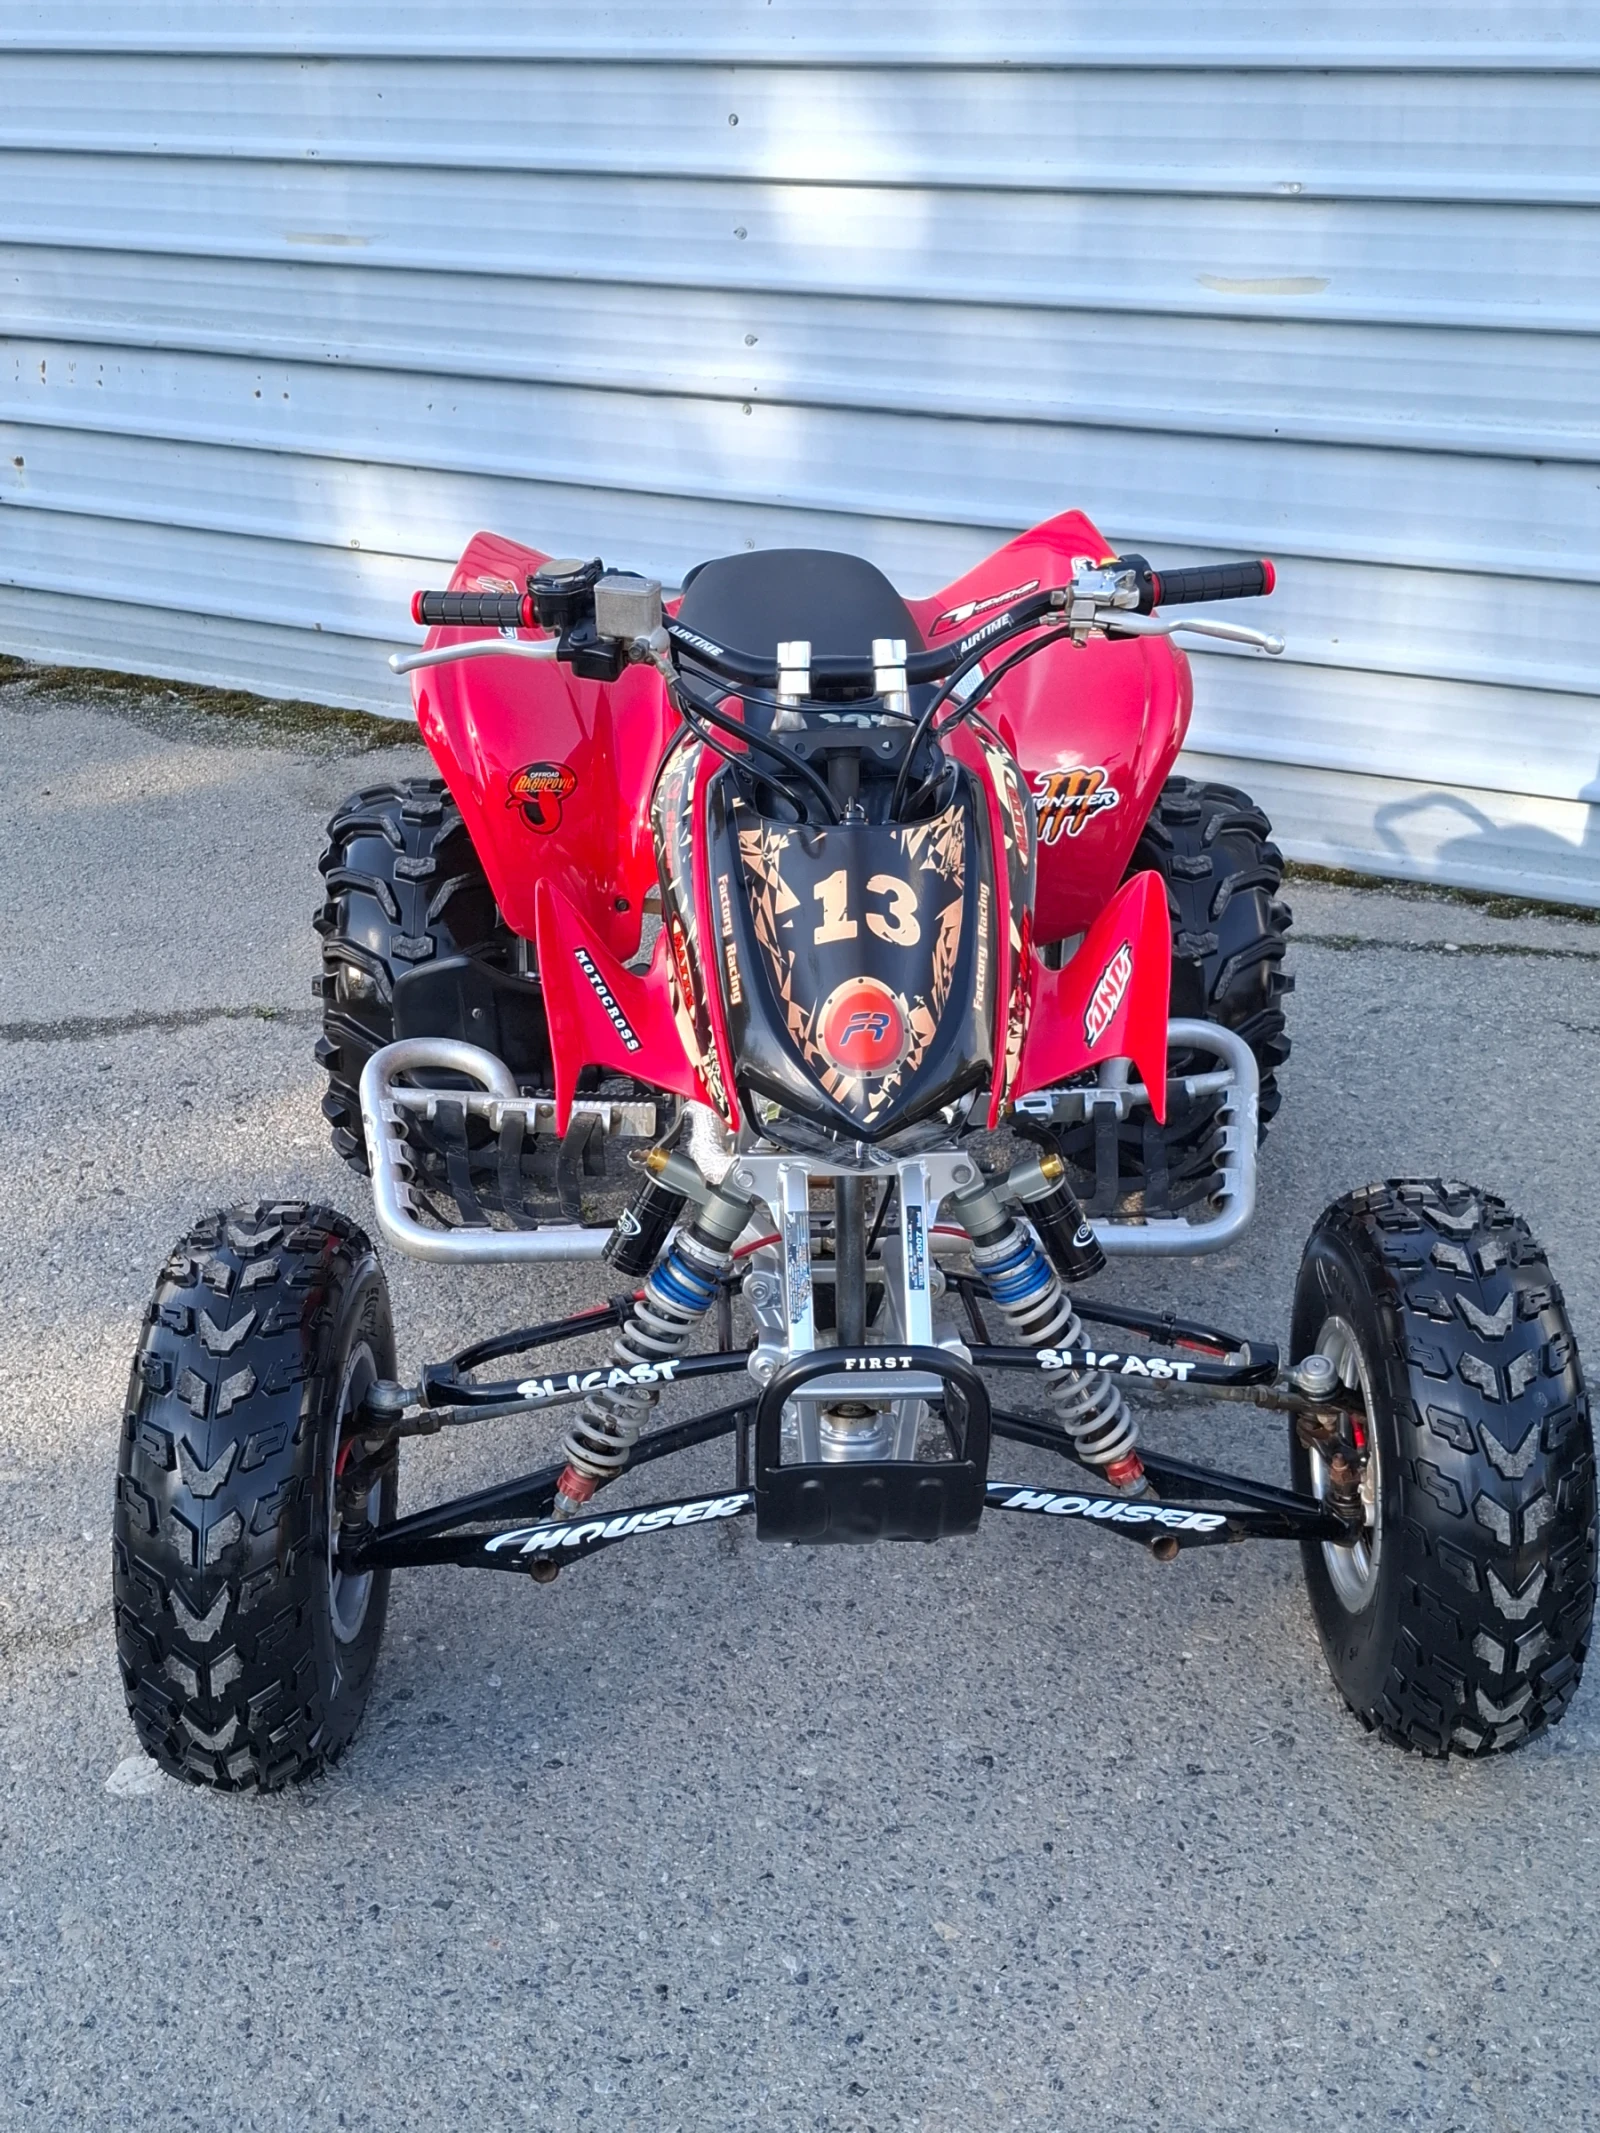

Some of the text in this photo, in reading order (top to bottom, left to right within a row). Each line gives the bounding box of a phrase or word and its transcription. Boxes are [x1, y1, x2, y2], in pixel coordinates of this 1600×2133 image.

[667, 624, 724, 657] AIRTIME
[960, 613, 1010, 653] AIRTIME
[529, 771, 560, 779] OFFROAD
[1031, 793, 1113, 811] ONSTER
[812, 869, 922, 947] 13
[717, 873, 742, 1006] Factory Racing
[973, 883, 990, 1012] Factory Racing
[574, 949, 640, 1052] MOTOCROSS
[915, 1231, 923, 1258] 2007
[516, 1360, 680, 1400] SLICAST
[844, 1356, 913, 1371] FIRST
[516, 1493, 750, 1554] HOUSER
[1002, 1489, 1227, 1533] HOUSER
